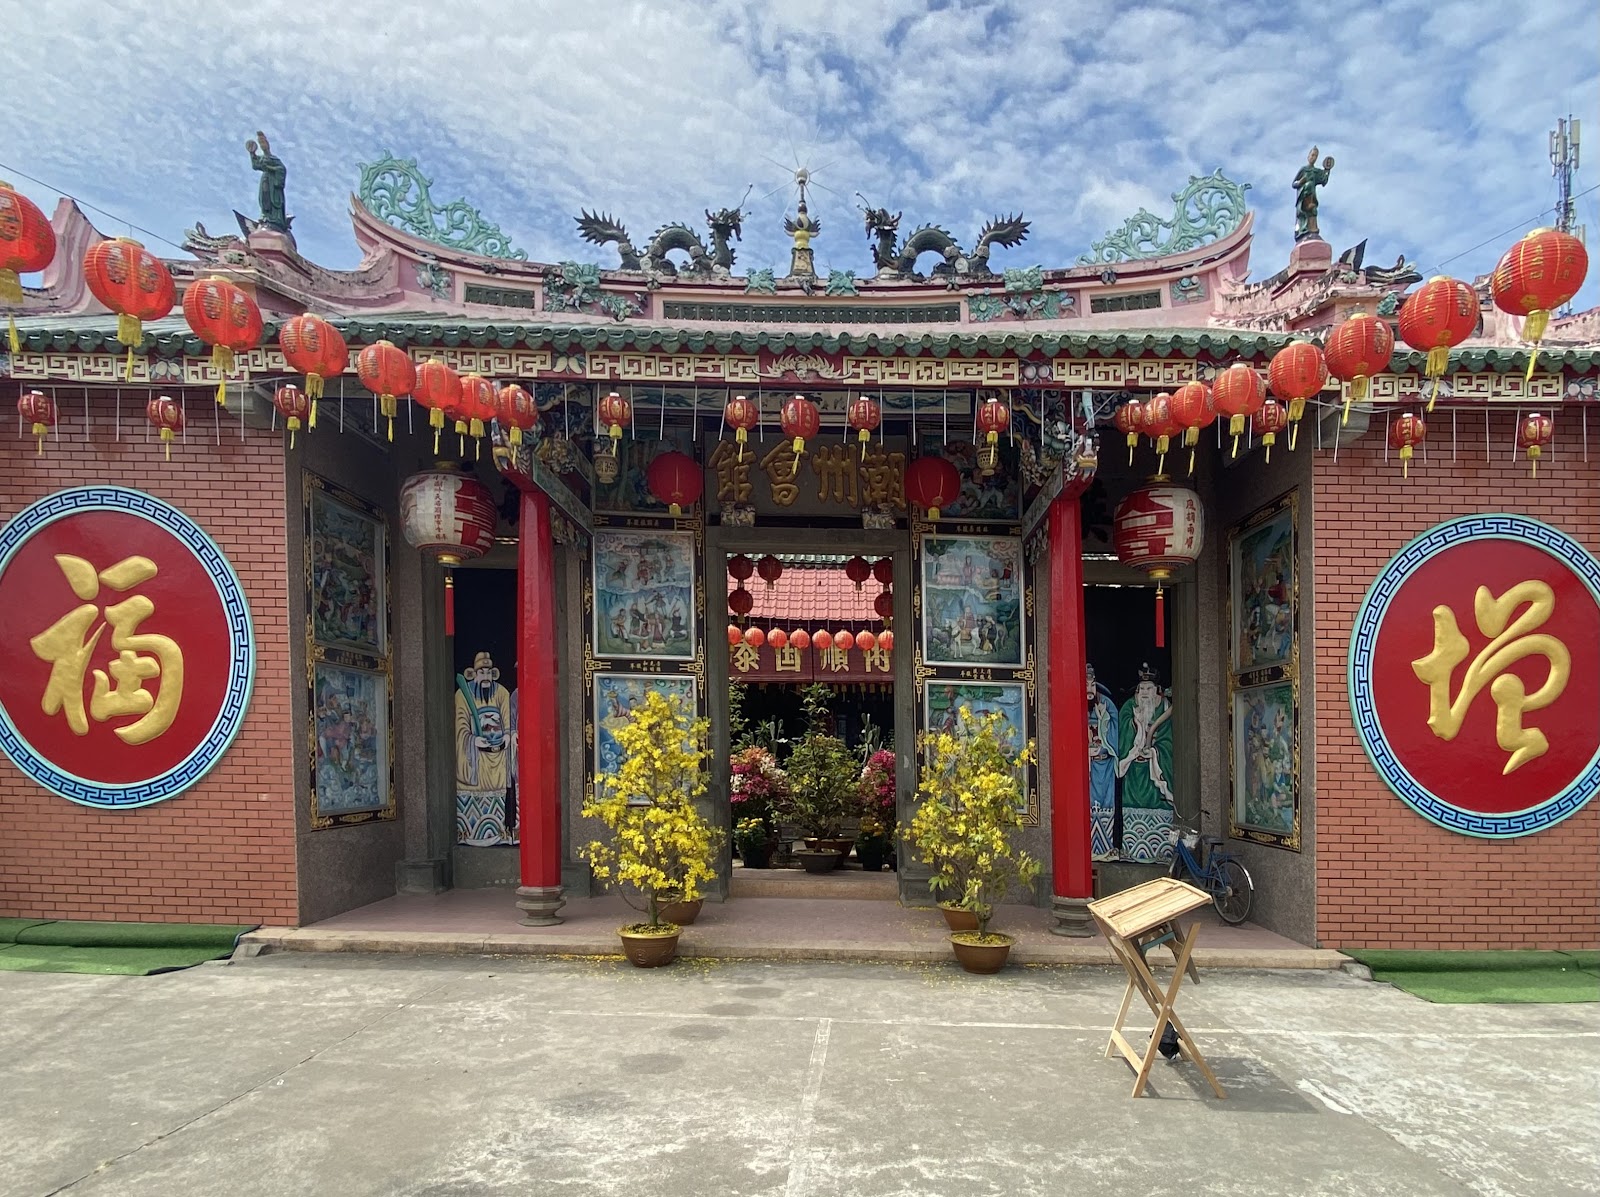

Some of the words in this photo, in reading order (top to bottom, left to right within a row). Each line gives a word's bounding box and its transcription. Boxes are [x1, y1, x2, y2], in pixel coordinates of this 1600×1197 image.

[708, 439, 907, 512] 潮州會館
[30, 553, 184, 746] 福
